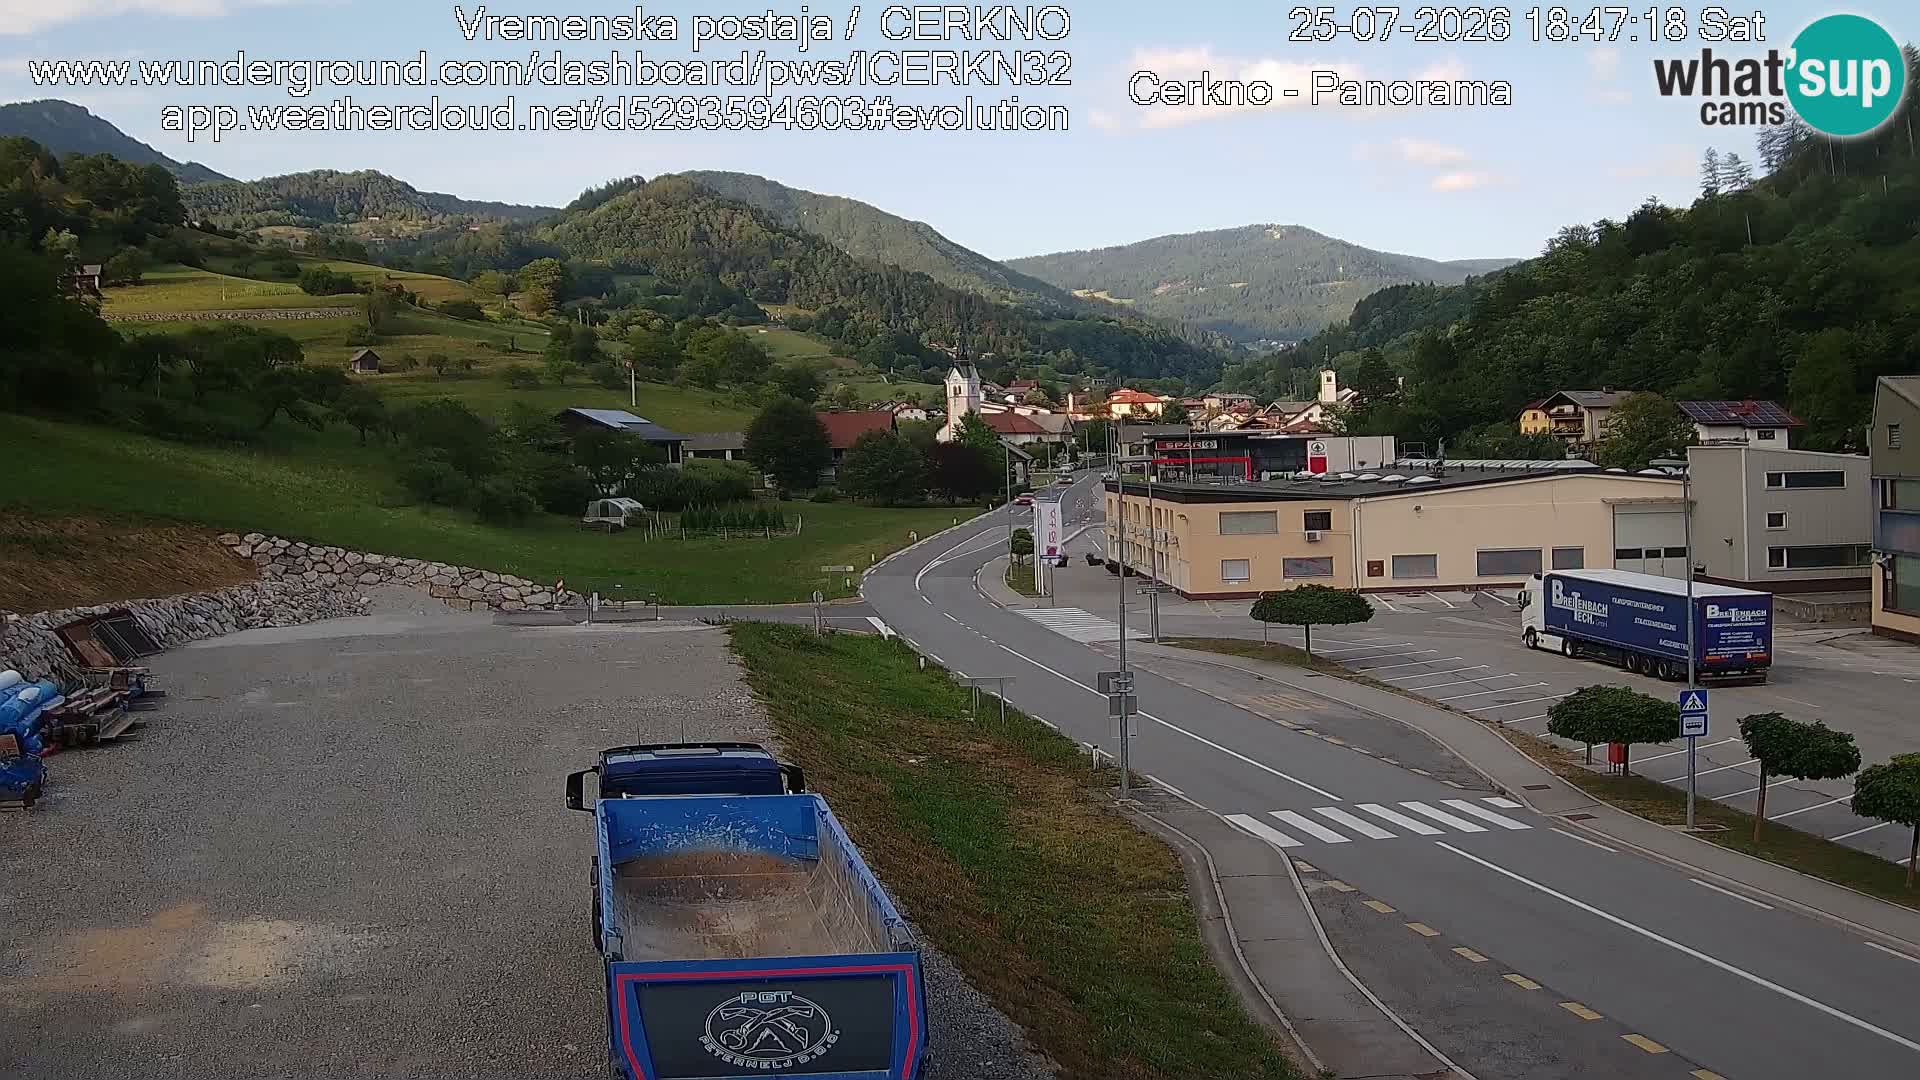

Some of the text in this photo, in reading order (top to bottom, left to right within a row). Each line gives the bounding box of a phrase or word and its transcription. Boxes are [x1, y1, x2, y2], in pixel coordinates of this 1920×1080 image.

[1552, 579, 1608, 617] BREITENBACH
[1706, 604, 1767, 619] BREITENBACH
[740, 990, 793, 1004] PGT
[698, 1035, 793, 1069] PETERNELJ
